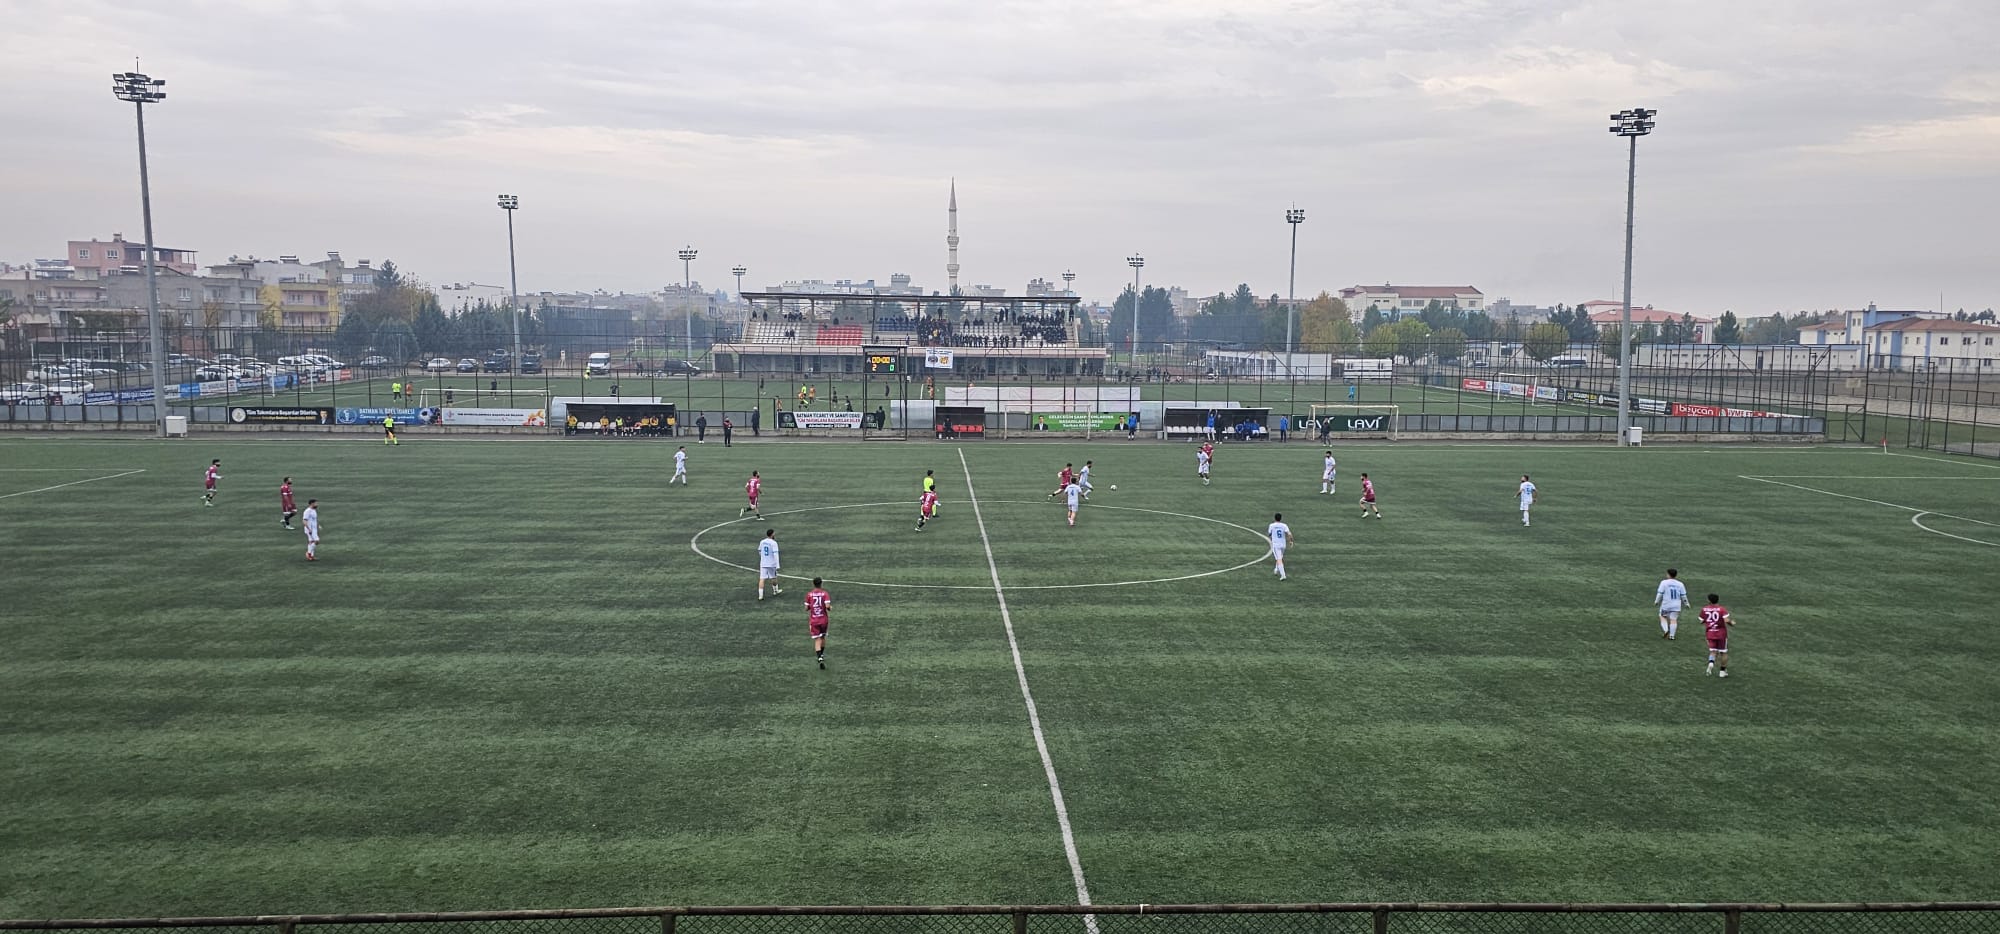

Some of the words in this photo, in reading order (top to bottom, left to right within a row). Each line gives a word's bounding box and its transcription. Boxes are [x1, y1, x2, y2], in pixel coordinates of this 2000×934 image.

[1679, 404, 1714, 416] beycan
[1276, 530, 1282, 538] 6
[764, 546, 769, 556] 9
[812, 596, 822, 607] 21
[1704, 611, 1720, 622] 20
